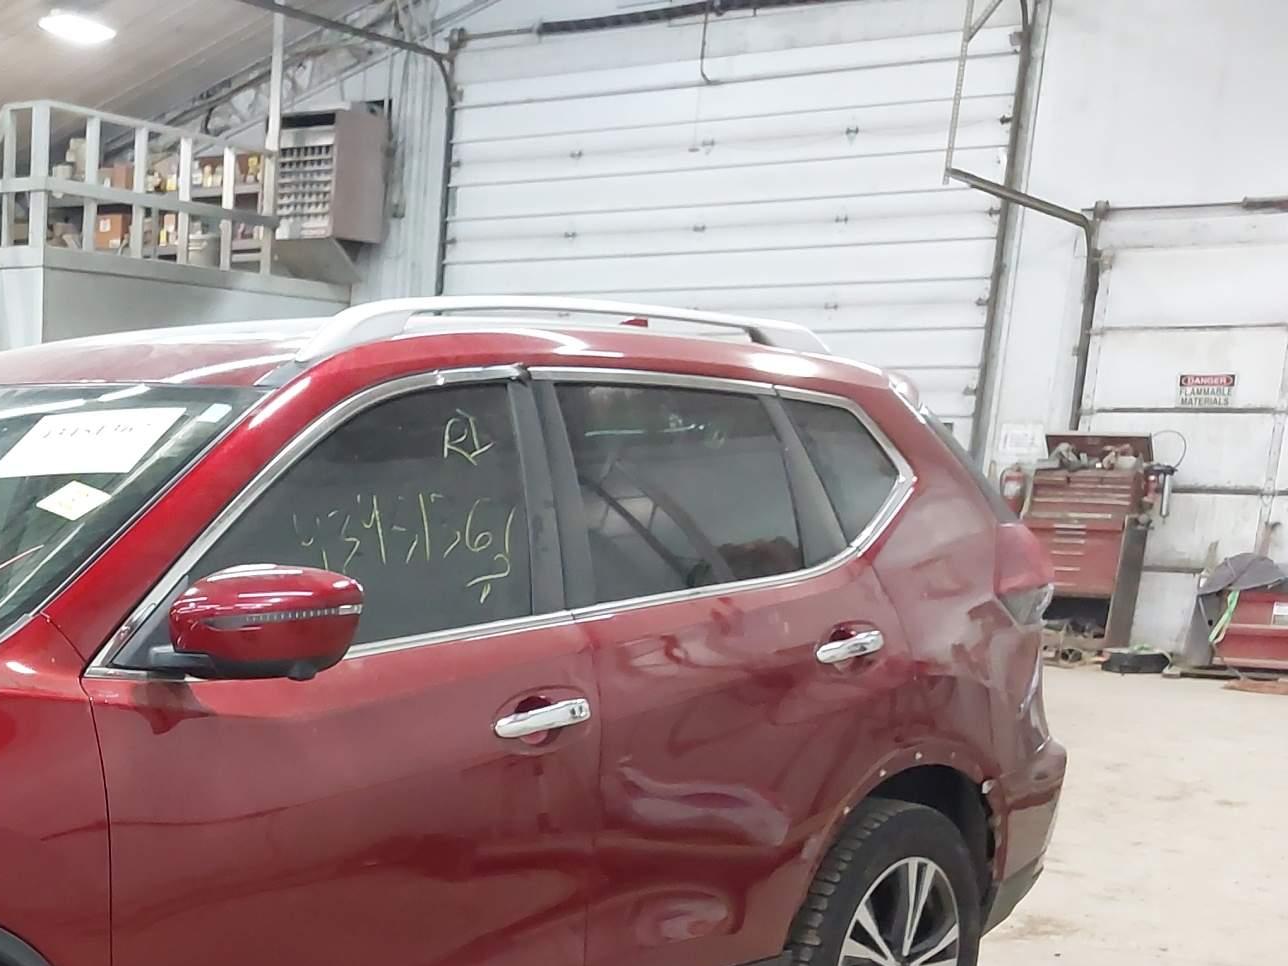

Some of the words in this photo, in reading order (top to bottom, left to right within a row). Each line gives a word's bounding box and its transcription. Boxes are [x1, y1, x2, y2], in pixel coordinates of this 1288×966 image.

[1187, 375, 1227, 385] DANGER
[1179, 387, 1232, 397] FLAMMABLE
[1181, 397, 1229, 406] MATERIALS
